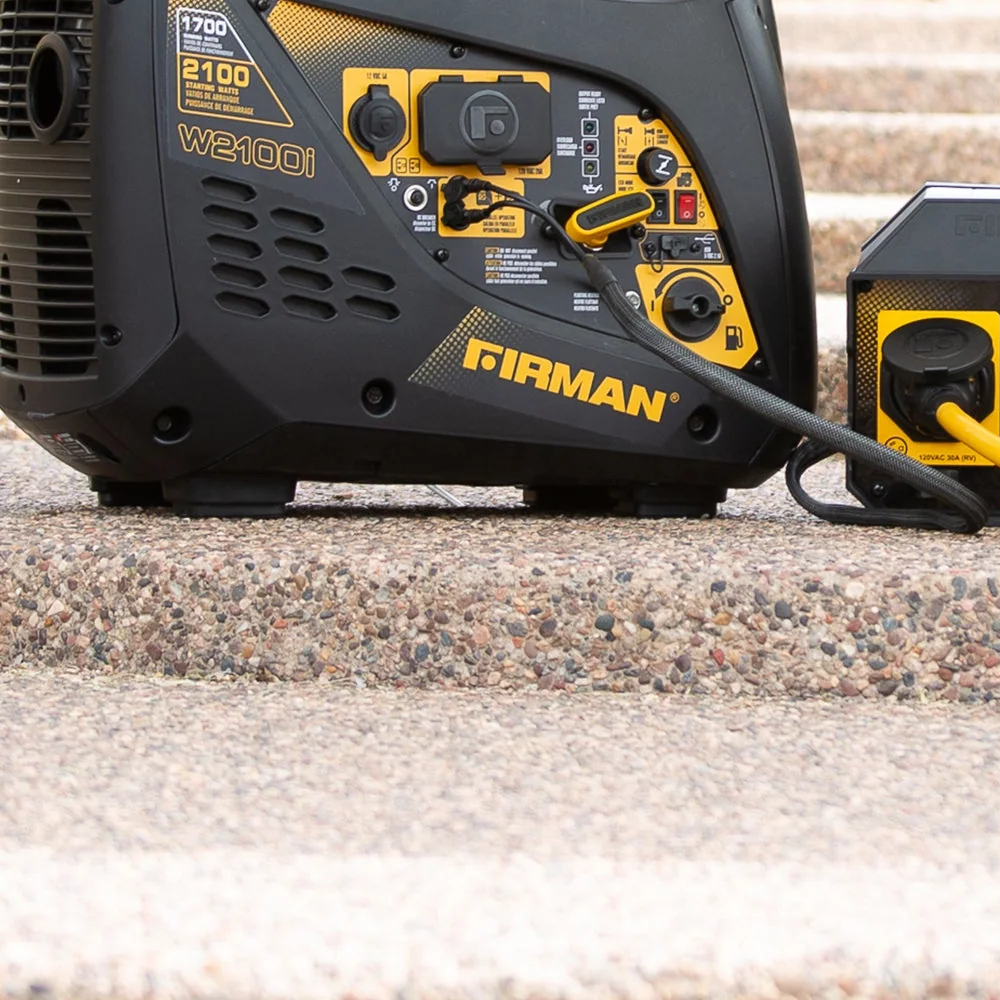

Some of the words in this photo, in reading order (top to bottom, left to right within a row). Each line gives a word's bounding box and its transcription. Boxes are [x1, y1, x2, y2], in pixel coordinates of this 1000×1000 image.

[181, 15, 227, 37] 1700
[182, 58, 250, 88] 2100
[177, 123, 317, 179] W2100i
